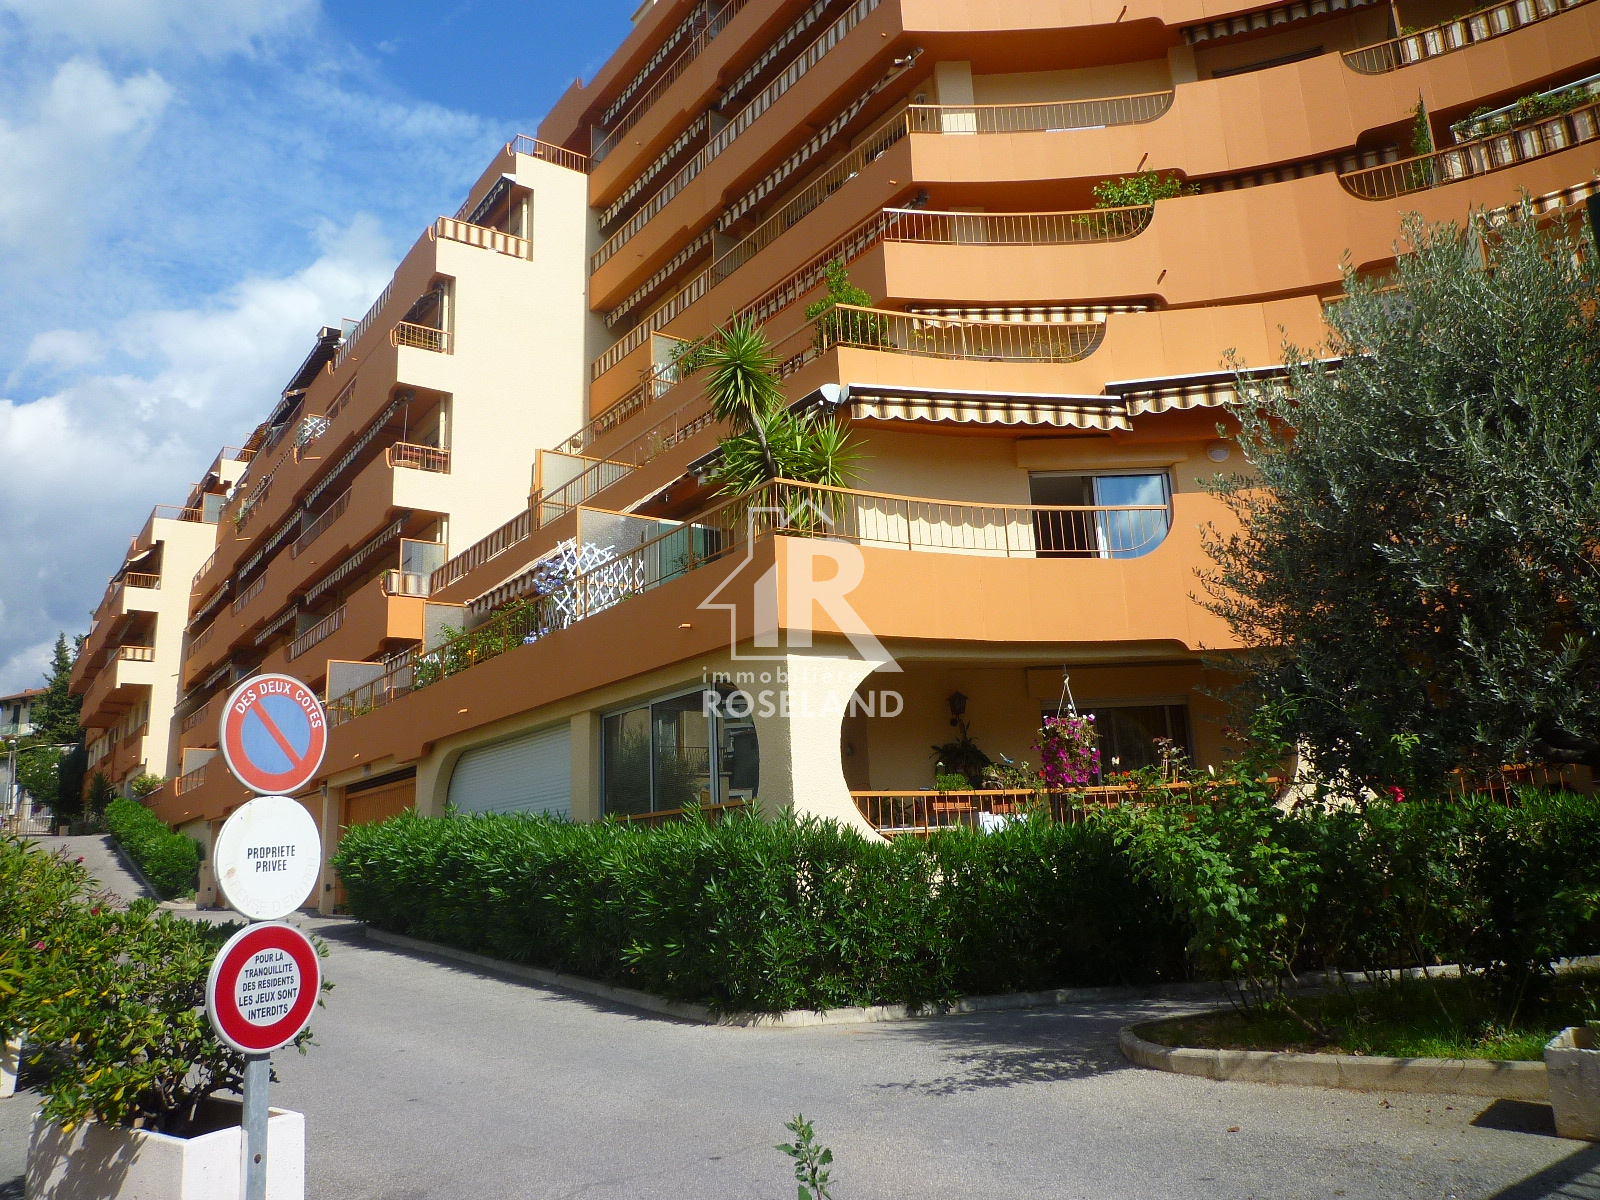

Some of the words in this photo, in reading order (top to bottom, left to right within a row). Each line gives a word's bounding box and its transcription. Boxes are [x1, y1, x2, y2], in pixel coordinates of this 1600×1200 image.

[234, 689, 257, 715] DES
[259, 681, 292, 694] DEUX
[295, 690, 322, 729] COTES
[247, 845, 296, 859] PROPRIETE
[255, 860, 288, 872] PRIVEE
[255, 954, 274, 964] POUR
[275, 952, 284, 961] LA
[242, 982, 256, 992] DES
[238, 995, 253, 1007] LES
[255, 991, 276, 1004] JEUX
[277, 987, 298, 1000] SONT
[248, 1003, 289, 1020] INTERDITS
